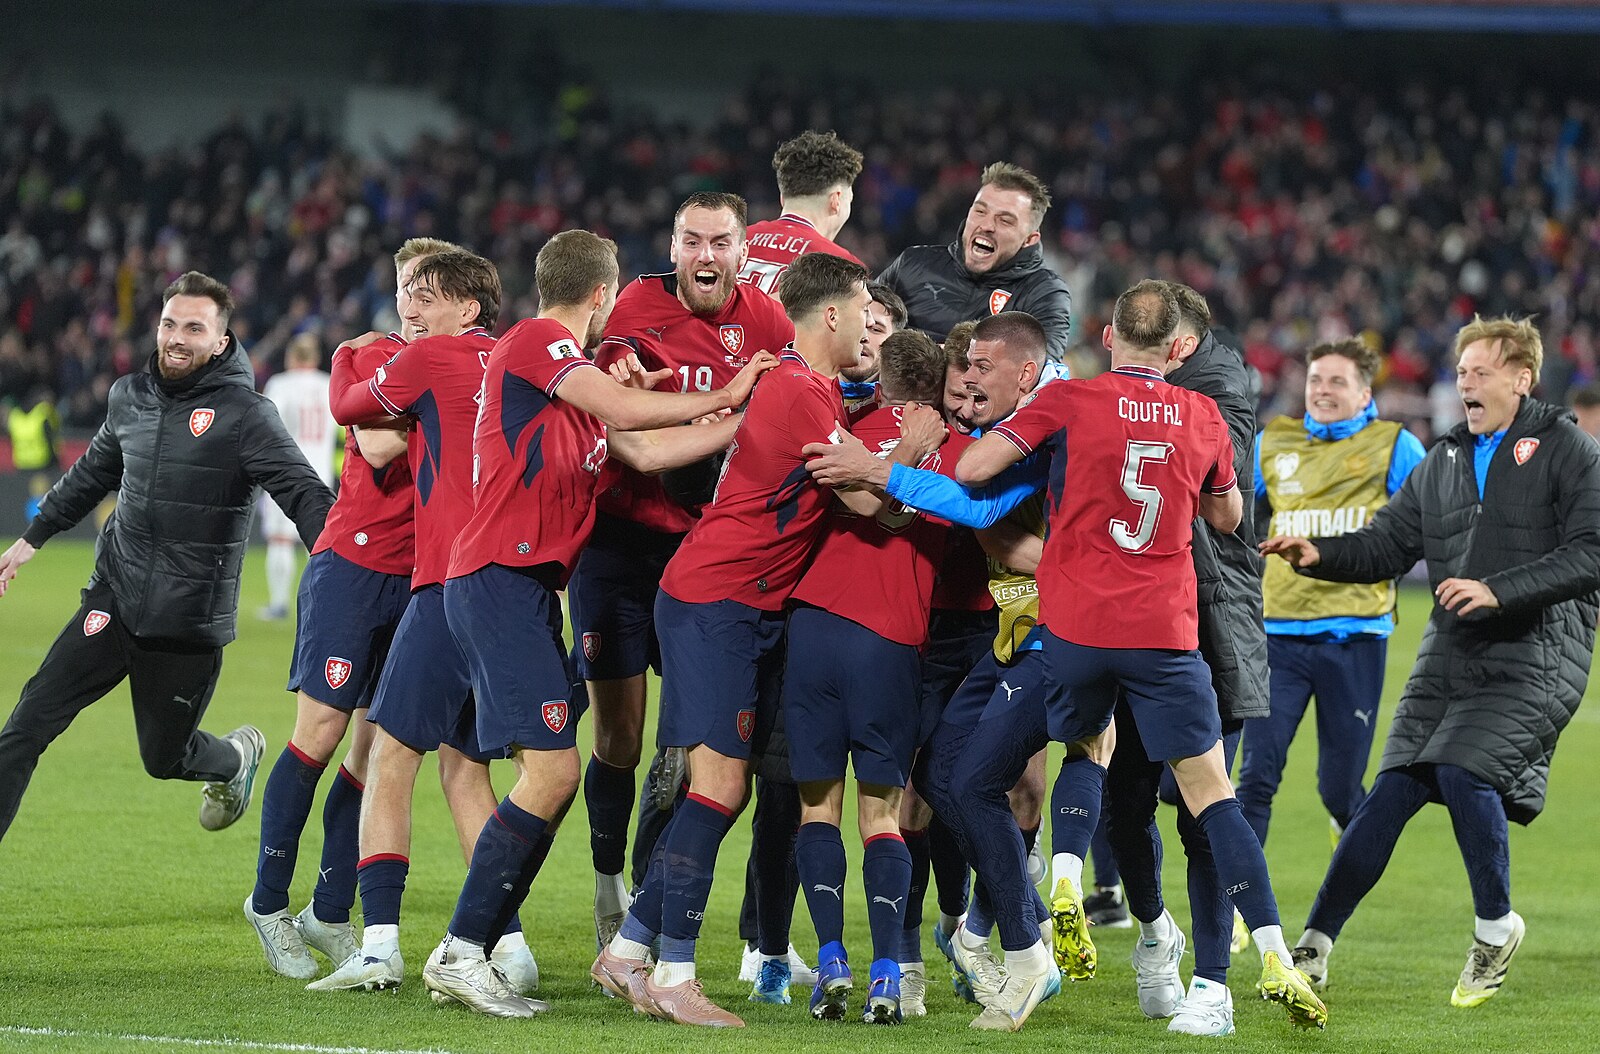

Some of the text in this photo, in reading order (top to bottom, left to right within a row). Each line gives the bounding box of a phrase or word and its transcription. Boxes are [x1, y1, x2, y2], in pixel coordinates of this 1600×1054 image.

[678, 365, 713, 394] 19
[1118, 397, 1183, 426] COUFAL
[1108, 439, 1176, 554] 5
[994, 583, 1039, 601] RESPEC
[1060, 806, 1089, 818] CZE
[264, 845, 286, 858] CZE
[1226, 880, 1250, 896] CZE
